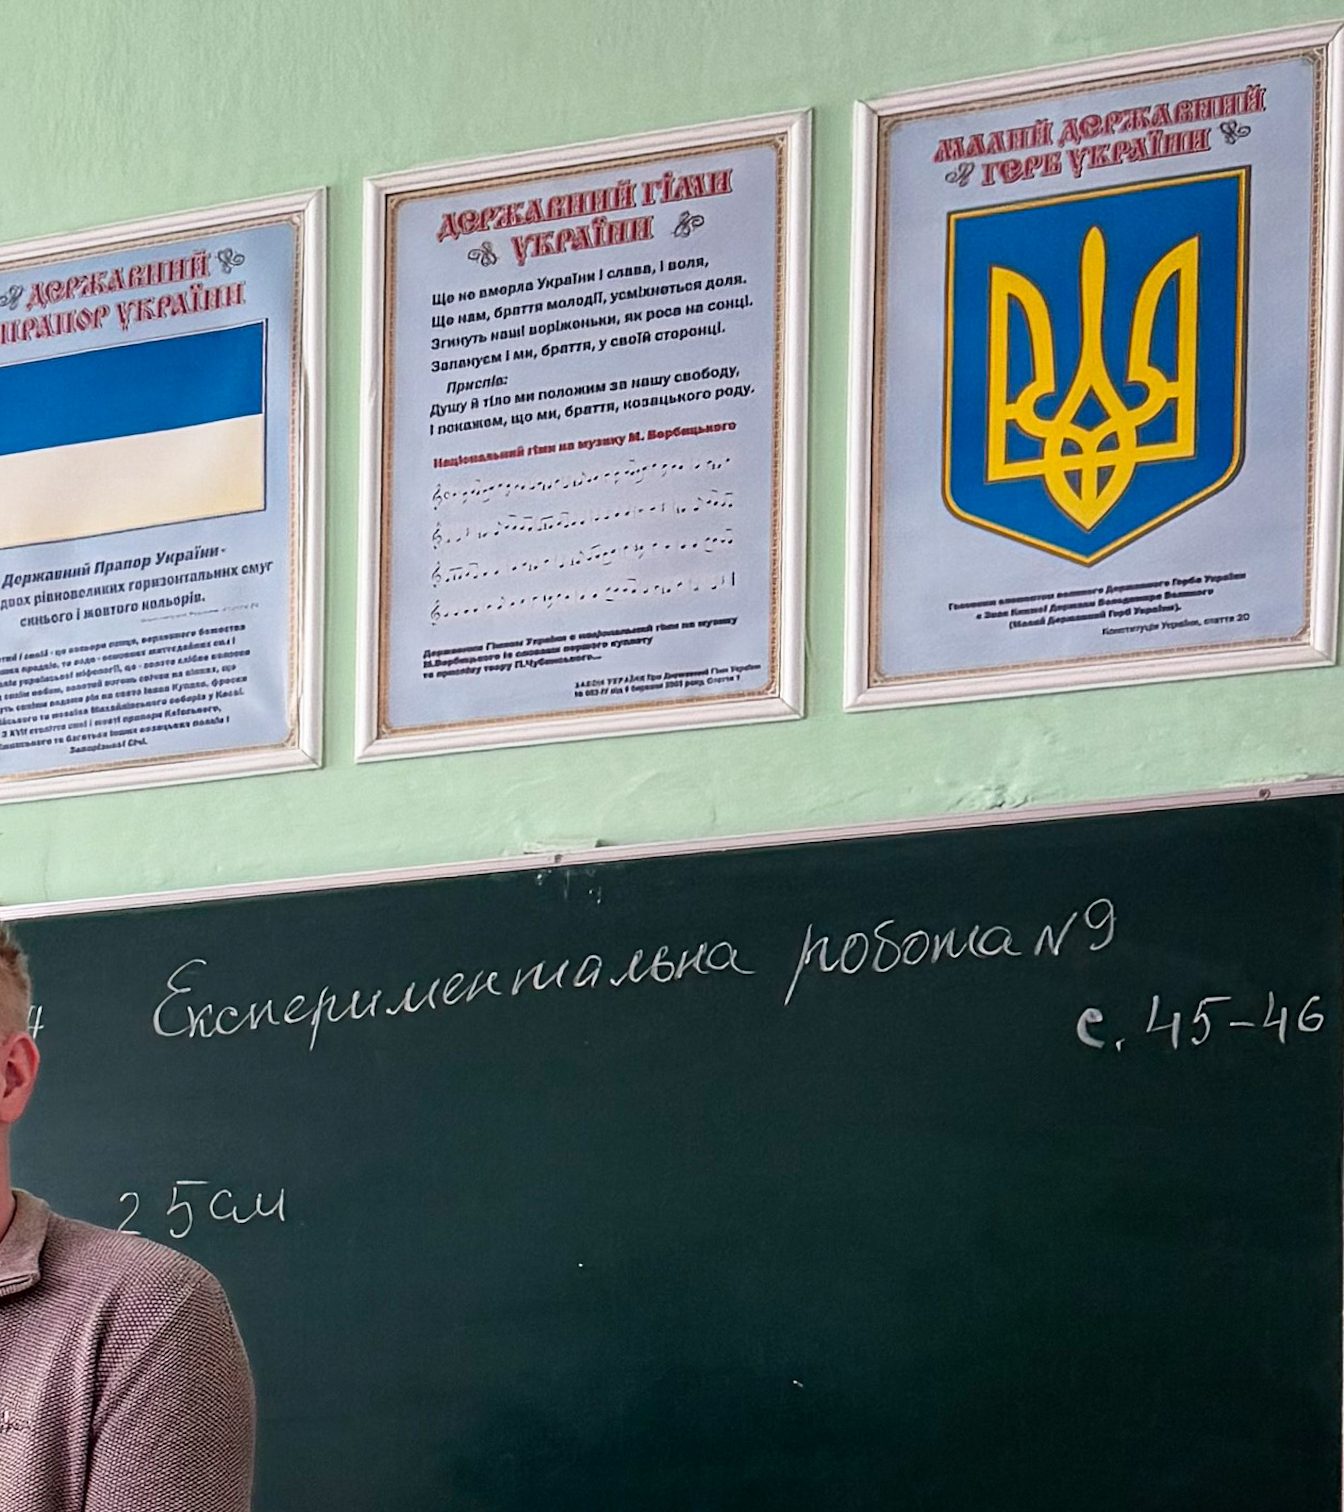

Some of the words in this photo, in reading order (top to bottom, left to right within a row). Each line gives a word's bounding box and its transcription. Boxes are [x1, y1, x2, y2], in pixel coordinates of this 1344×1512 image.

[1065, 127, 1212, 179] УКРАЇНИ
[510, 215, 655, 266] УКРАЇНИ
[432, 292, 455, 306] Ще
[458, 291, 475, 302] не
[479, 281, 534, 299] вмерла
[537, 272, 595, 290] України
[607, 264, 656, 279] слава,
[668, 257, 709, 271] воля,
[432, 315, 454, 328] Ще
[458, 311, 490, 324] нам,
[494, 302, 543, 320] браття
[547, 291, 607, 310] молодії,
[610, 280, 702, 305] усміхнеться
[705, 275, 747, 291] доля.
[431, 334, 487, 350] Згинуть
[491, 325, 525, 341] наші
[529, 315, 620, 336] воріженьки,
[624, 311, 642, 323] як
[646, 307, 682, 322] роса
[685, 303, 704, 315] на
[707, 294, 753, 312] сонці.
[431, 353, 502, 373] Запануєм
[513, 349, 538, 360] ми,
[541, 341, 596, 358] браття,
[598, 339, 607, 352] у
[610, 331, 651, 347] своїй
[654, 321, 726, 342] сторонці.
[429, 401, 467, 418] Душу
[471, 397, 479, 410] й
[483, 395, 511, 407] тіло
[515, 392, 535, 403] ми
[538, 383, 606, 401] положим
[609, 380, 627, 391] за
[631, 374, 671, 389] нашу
[674, 366, 740, 383] свободу,
[438, 416, 507, 435] покажем,
[511, 413, 533, 425] що
[537, 409, 561, 421] ми,
[564, 402, 619, 418] браття,
[623, 390, 712, 410] козацького
[715, 384, 755, 400] роду.
[446, 375, 508, 395] Приспів:
[558, 442, 575, 452] на
[578, 435, 626, 450] музику
[628, 431, 645, 443] М.
[647, 421, 737, 441] Вербицького
[0, 596, 31, 611] двох
[34, 583, 125, 607] рівновеликих
[128, 566, 239, 592] горизонтальних
[241, 561, 273, 575] смуг
[1, 562, 91, 590] Державний
[94, 557, 151, 576] Прапор
[20, 612, 73, 627] синього
[83, 602, 139, 619] жовтого
[142, 591, 205, 611] кольорів.
[153, 937, 756, 1050] Експериментальна
[783, 919, 1023, 1006] робота
[1145, 991, 1325, 1050] 45-46
